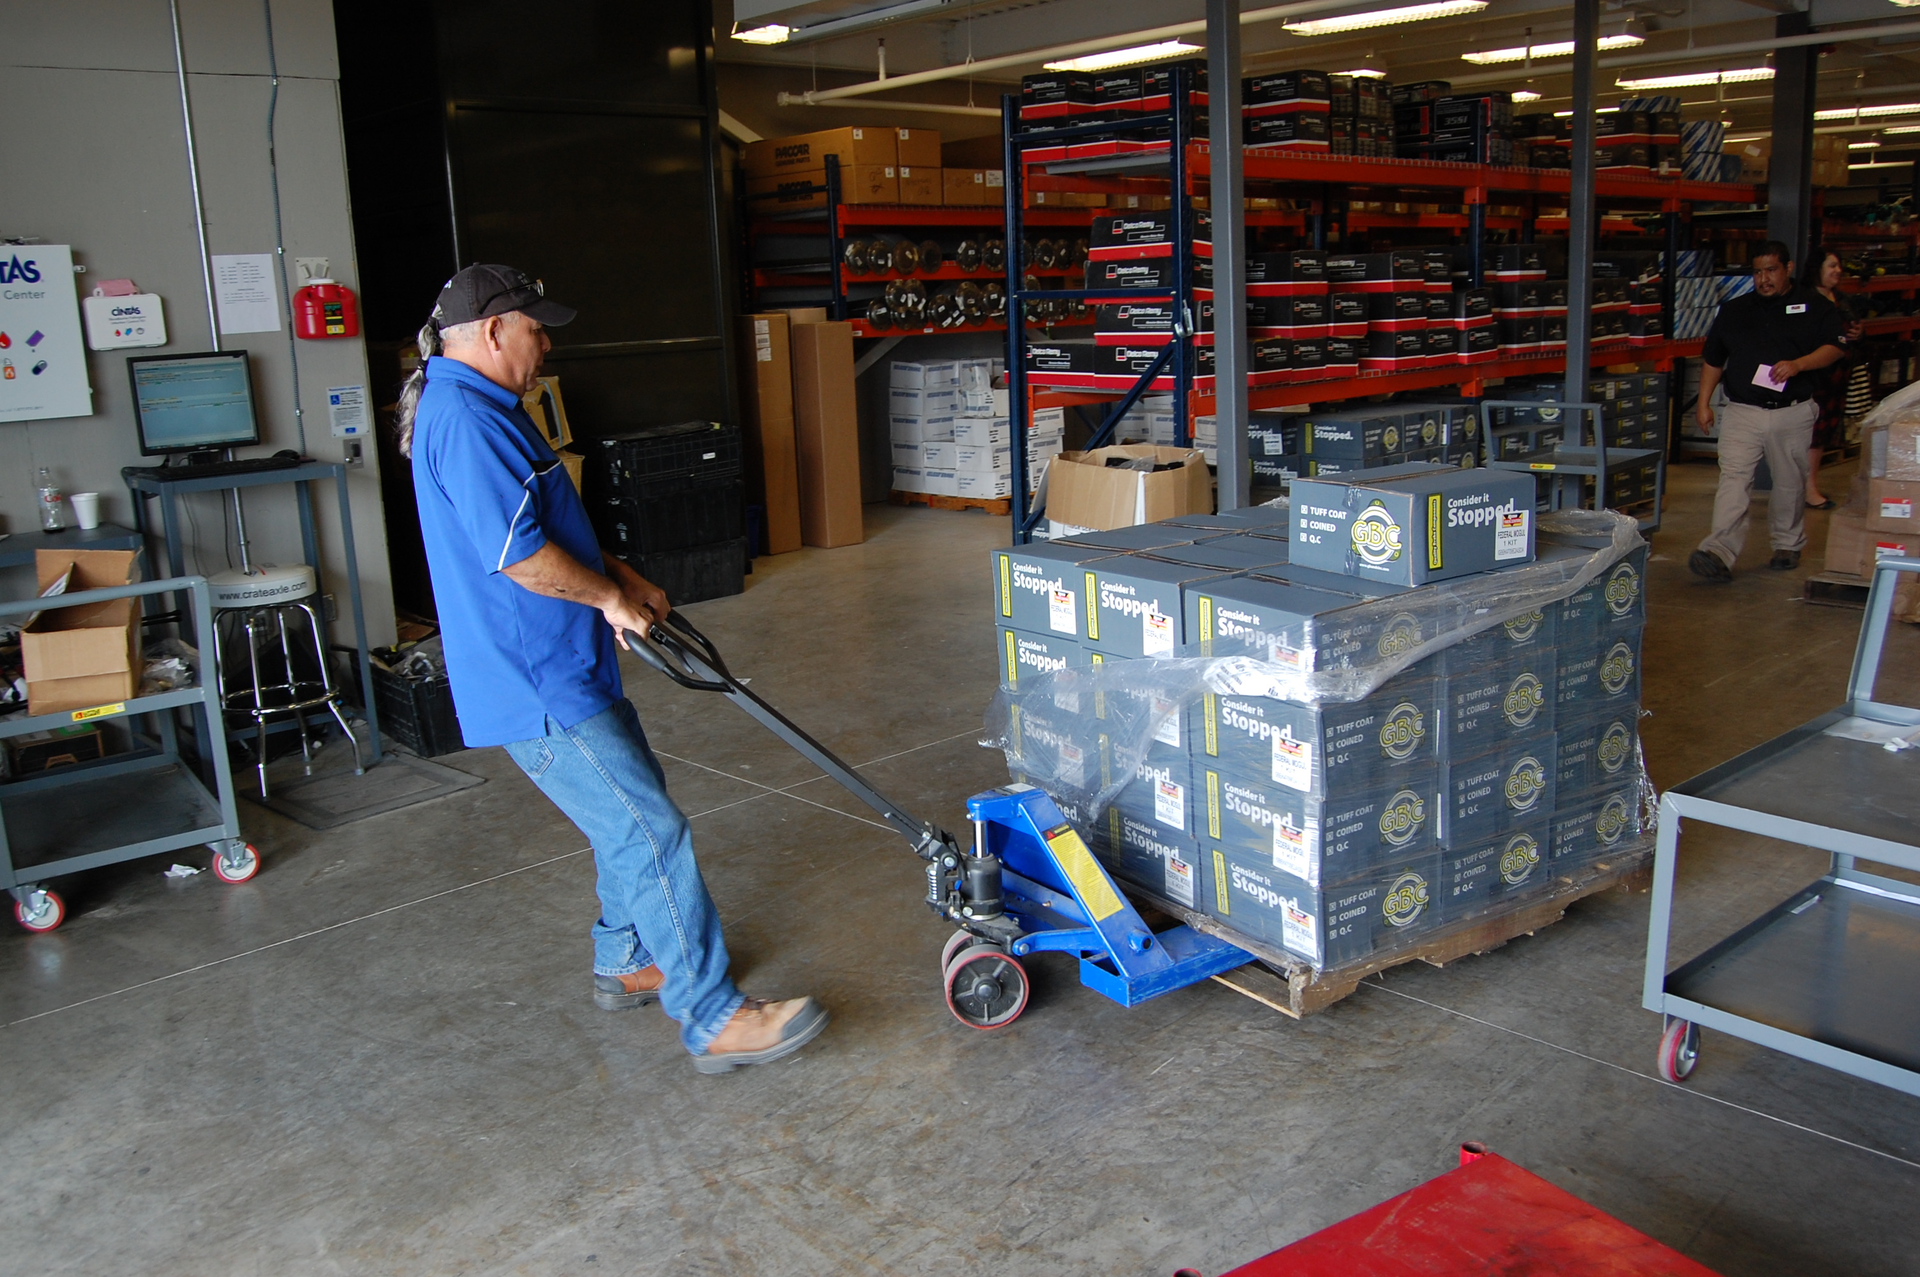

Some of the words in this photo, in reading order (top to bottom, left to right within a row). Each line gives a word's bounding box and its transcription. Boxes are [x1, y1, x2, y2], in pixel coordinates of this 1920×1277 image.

[4, 290, 45, 299] Center
[111, 307, 141, 316] CINTAS
[1448, 496, 1481, 509] Consider
[1482, 494, 1489, 503] it
[1310, 507, 1327, 518] TUFF
[1328, 508, 1347, 520] COAT
[1309, 520, 1336, 533] COINED
[1352, 519, 1401, 550] GBC
[1012, 562, 1037, 574] Consider
[1038, 567, 1043, 575] it
[218, 581, 307, 600] www.crateaxle.com
[1100, 581, 1129, 595] Consider
[1130, 585, 1136, 596] it
[1605, 574, 1639, 602] GBC
[1572, 593, 1593, 604] COINED
[1217, 607, 1252, 623] Consider
[1253, 615, 1260, 625] it
[1018, 639, 1041, 651] Consider
[1042, 644, 1048, 653] it
[1378, 625, 1425, 657] GBC
[1567, 664, 1582, 674] TUFF
[1583, 658, 1597, 669] COAT
[1600, 652, 1635, 682] GBC
[1567, 675, 1588, 686] COINED
[1466, 690, 1482, 701] TUFF
[1482, 685, 1499, 696] COAT
[1504, 683, 1544, 715] GBC
[1221, 697, 1256, 715] Consider
[1257, 706, 1264, 717] it
[1466, 702, 1490, 715] COINED
[1336, 723, 1354, 734] TUFF
[1355, 716, 1374, 728] COAT
[1380, 713, 1425, 747] GBC
[1336, 734, 1364, 748] COINED
[1598, 732, 1631, 761] GBC
[1467, 776, 1482, 786] TUFF
[1483, 770, 1499, 782] COAT
[1505, 766, 1545, 799] GBC
[1224, 783, 1258, 801] Consider
[1259, 793, 1266, 804] it
[1467, 787, 1491, 800] COINED
[1336, 813, 1354, 824] TUFF
[1355, 805, 1374, 817] COAT
[1379, 799, 1425, 834] GBC
[1596, 803, 1628, 834] GBC
[1123, 817, 1150, 836] Consider
[1151, 828, 1158, 838] it
[1336, 822, 1363, 837] COINED
[1462, 854, 1477, 867] TUFF
[1478, 847, 1494, 860] COAT
[1500, 842, 1540, 875] GBC
[1230, 862, 1263, 883] Consider
[1264, 875, 1271, 887] it
[1463, 864, 1486, 879] COINED
[1339, 896, 1357, 908] TUFF
[1358, 888, 1377, 901] COAT
[1383, 882, 1429, 917] GBC
[1339, 906, 1367, 921] COINED
